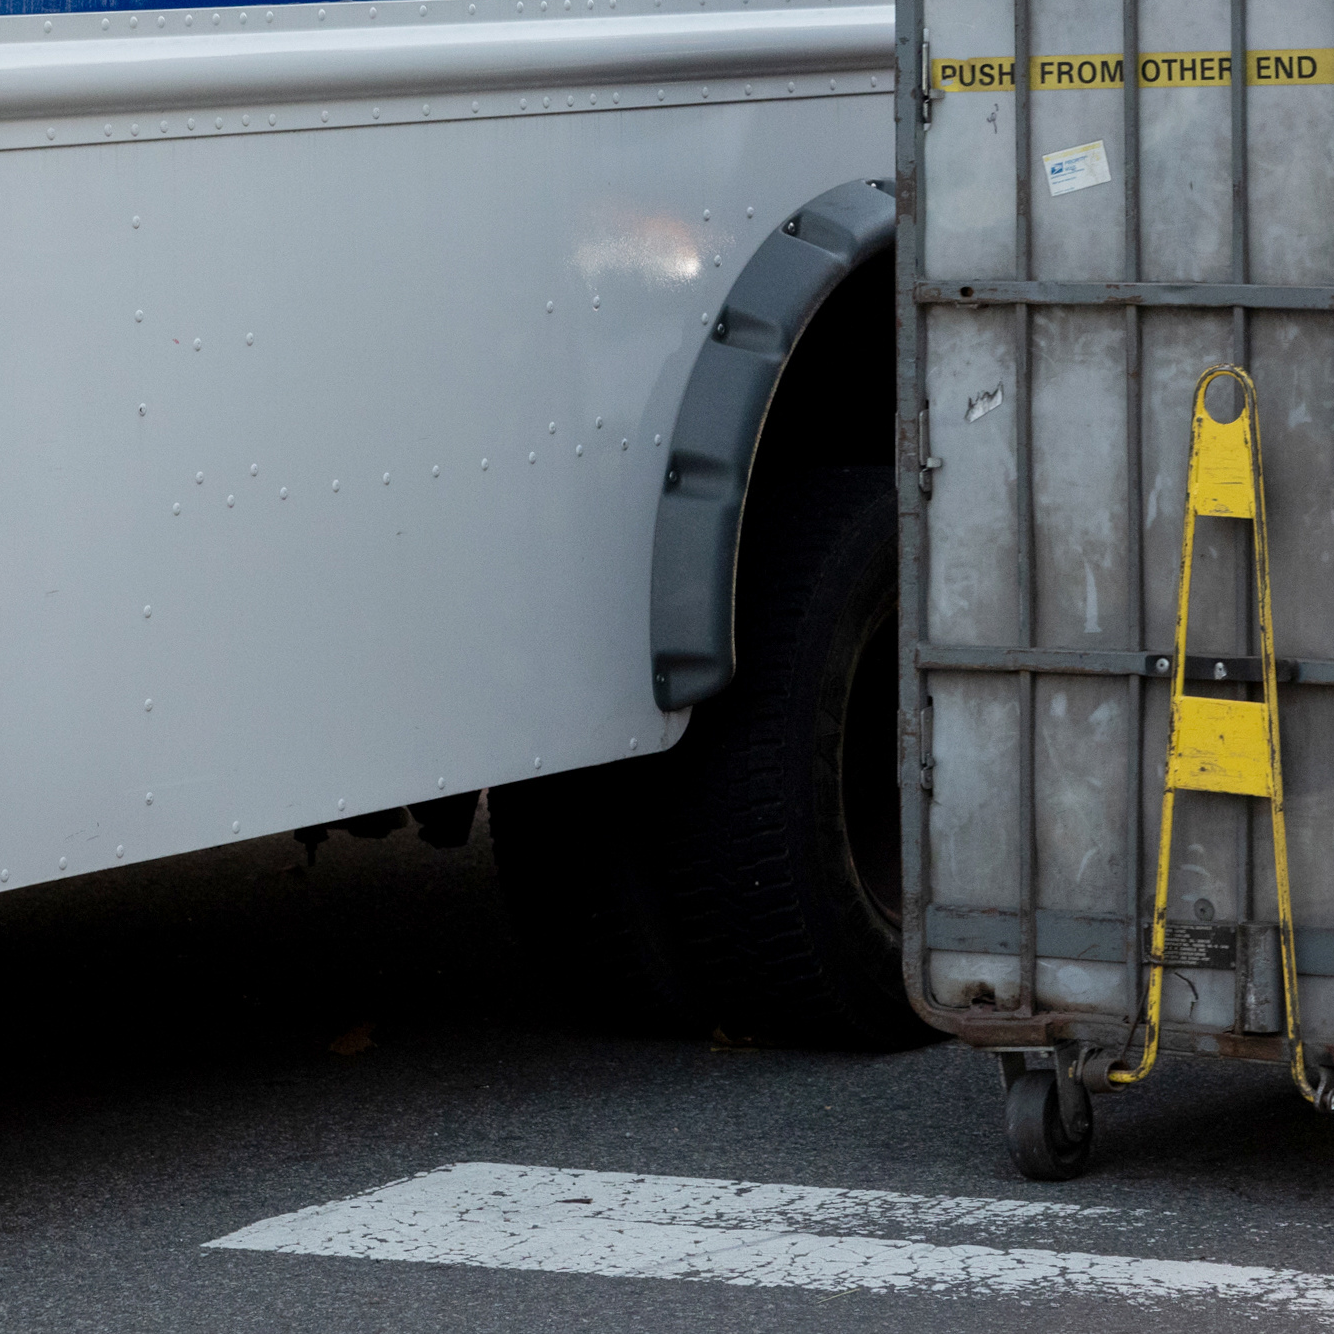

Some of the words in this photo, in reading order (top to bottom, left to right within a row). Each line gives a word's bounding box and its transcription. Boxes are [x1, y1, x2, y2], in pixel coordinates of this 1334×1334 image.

[941, 63, 1015, 87] PUSH
[1040, 60, 1124, 84] FROM
[1141, 57, 1231, 83] OTHER
[1256, 55, 1317, 80] END
